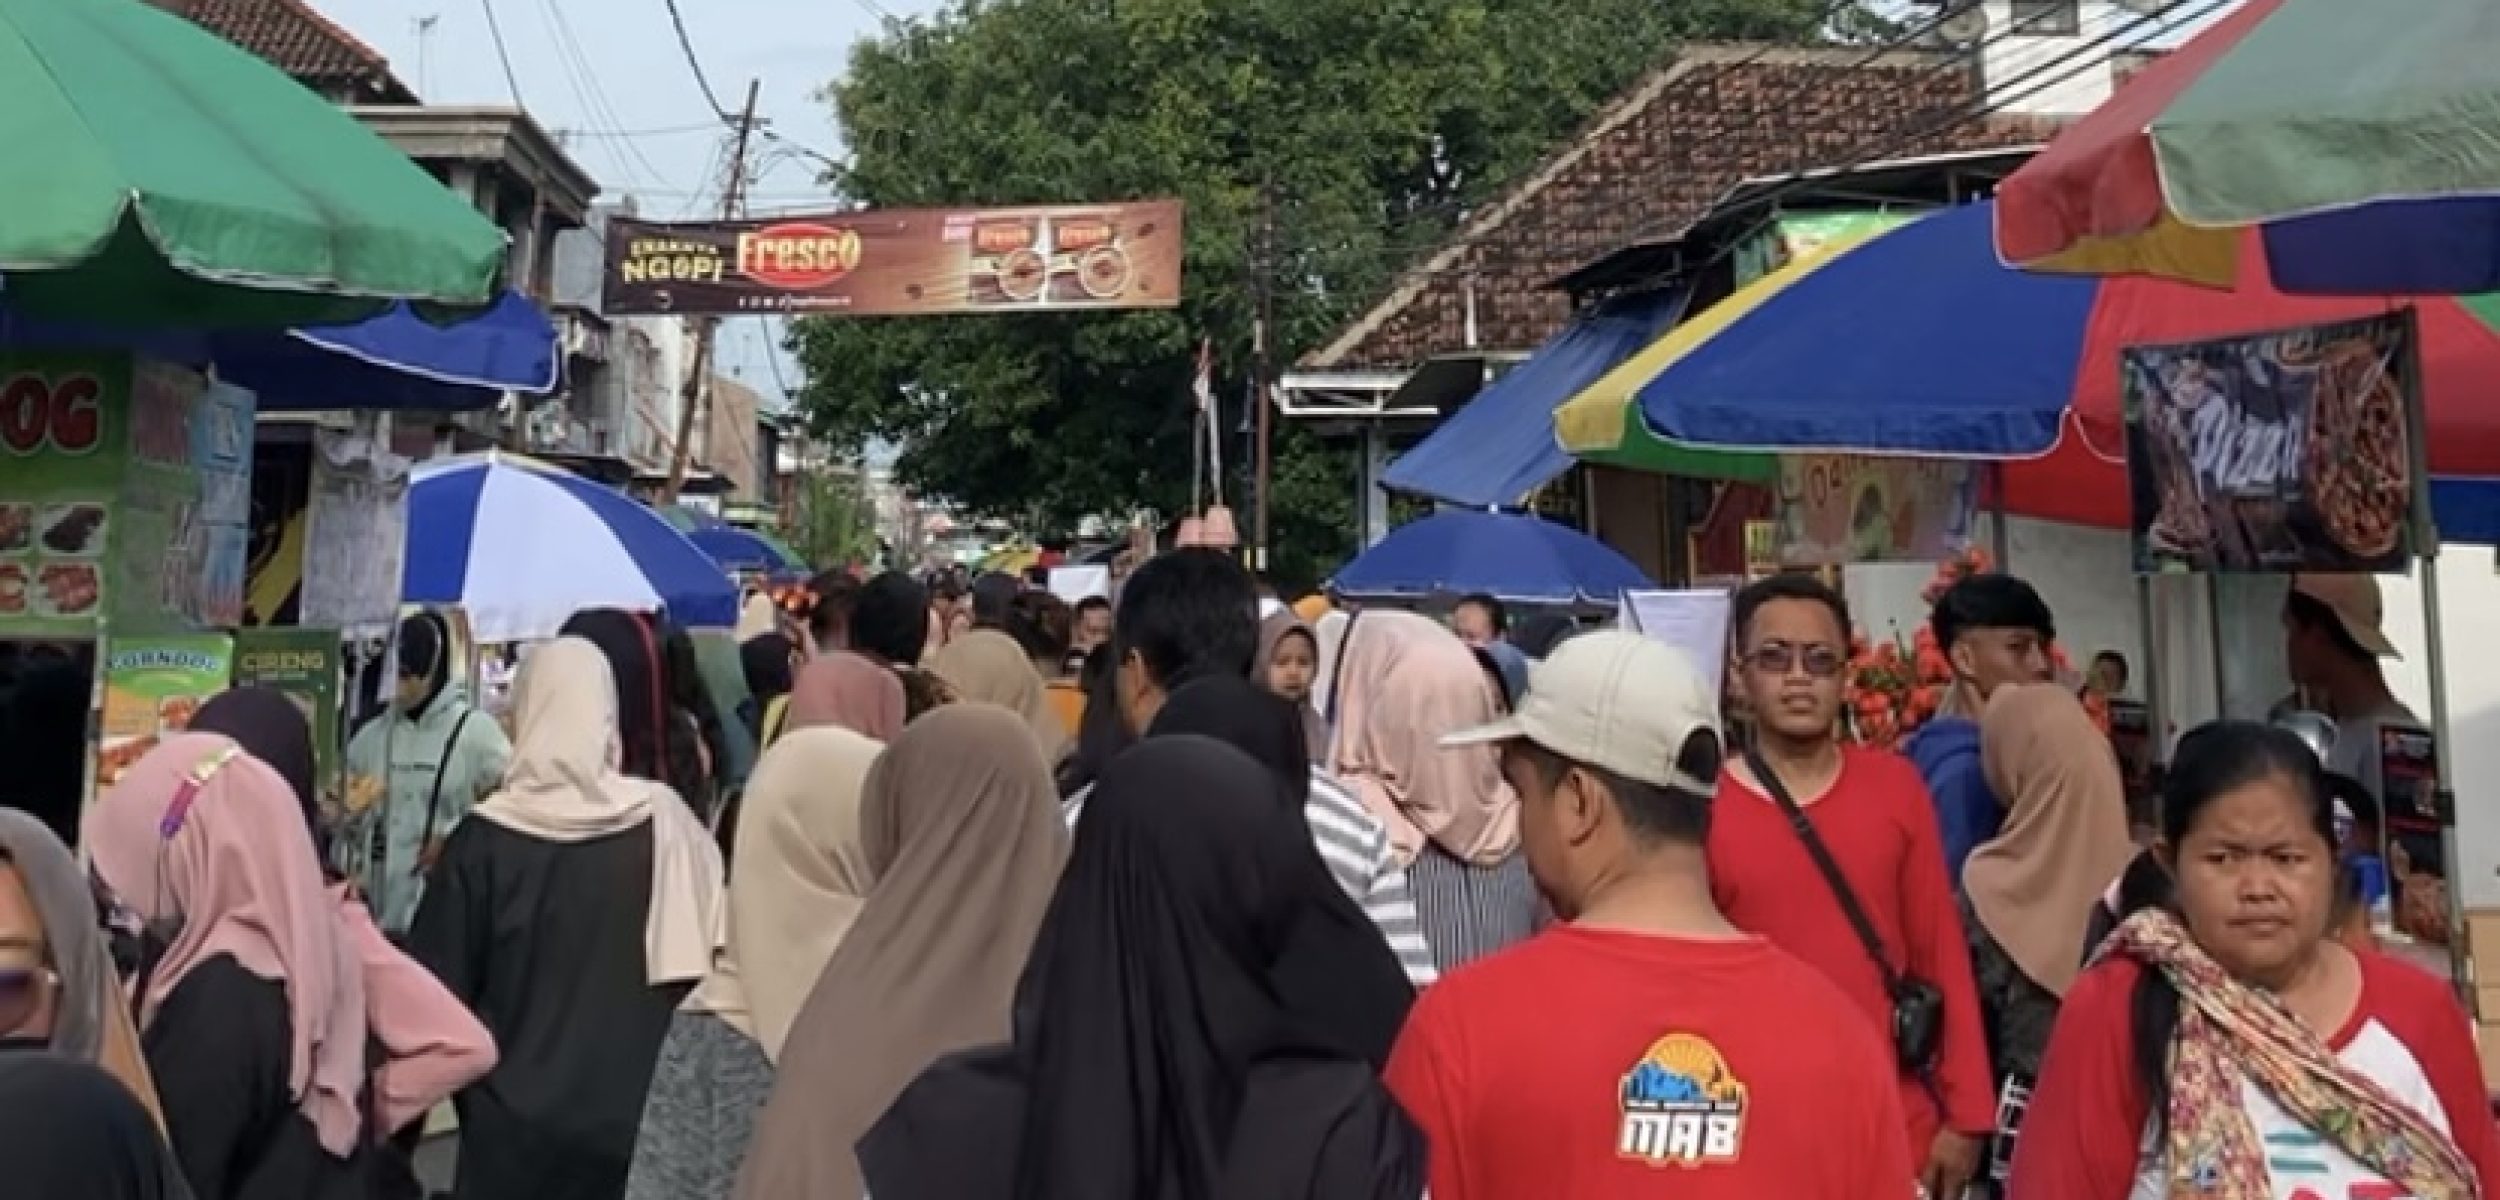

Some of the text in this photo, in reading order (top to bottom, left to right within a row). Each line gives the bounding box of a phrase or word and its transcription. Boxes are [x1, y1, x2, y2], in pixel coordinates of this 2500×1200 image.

[622, 256, 723, 285] NGOPI
[737, 228, 862, 273] Fresco
[0, 372, 100, 453] OG
[1621, 1111, 1738, 1159] MAB
